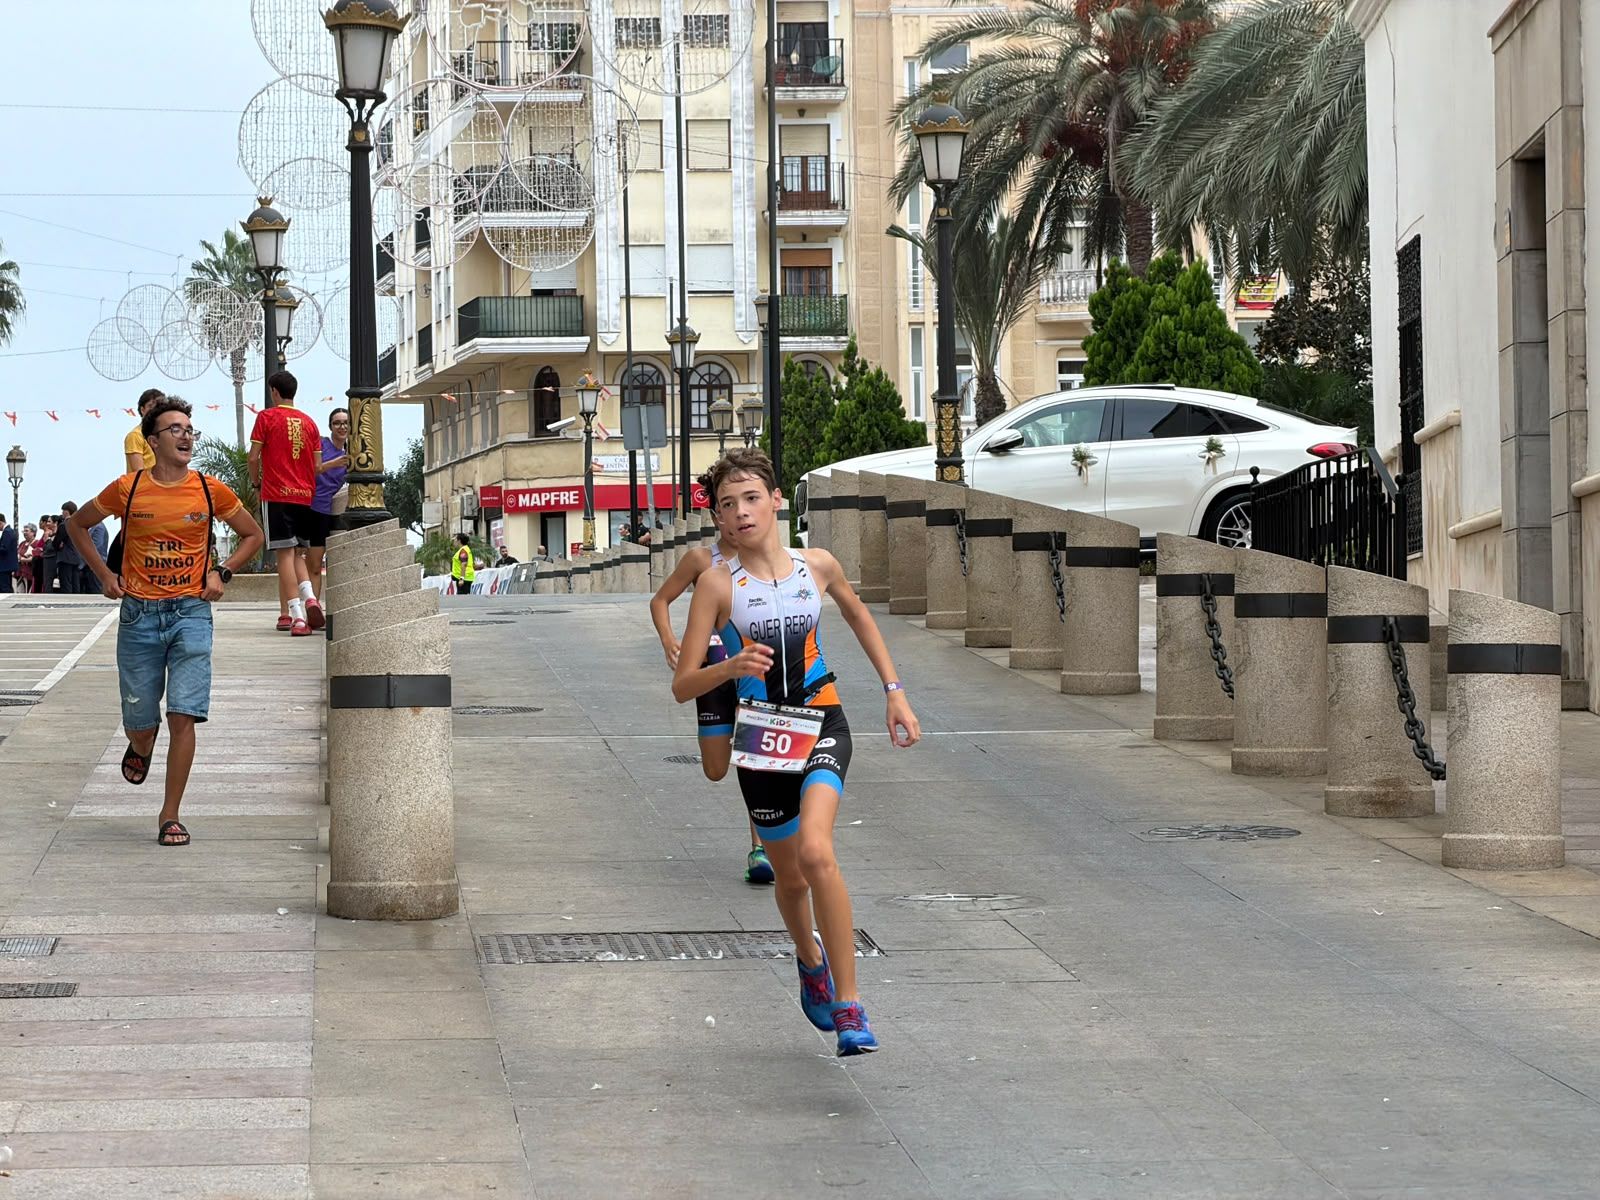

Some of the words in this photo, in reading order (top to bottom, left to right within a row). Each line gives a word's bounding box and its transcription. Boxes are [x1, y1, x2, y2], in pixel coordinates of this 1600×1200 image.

[518, 490, 579, 507] MAPFRE
[155, 540, 184, 551] TRI
[144, 556, 194, 568] DINGO
[148, 574, 191, 586] TEAM
[760, 731, 792, 755] 50
